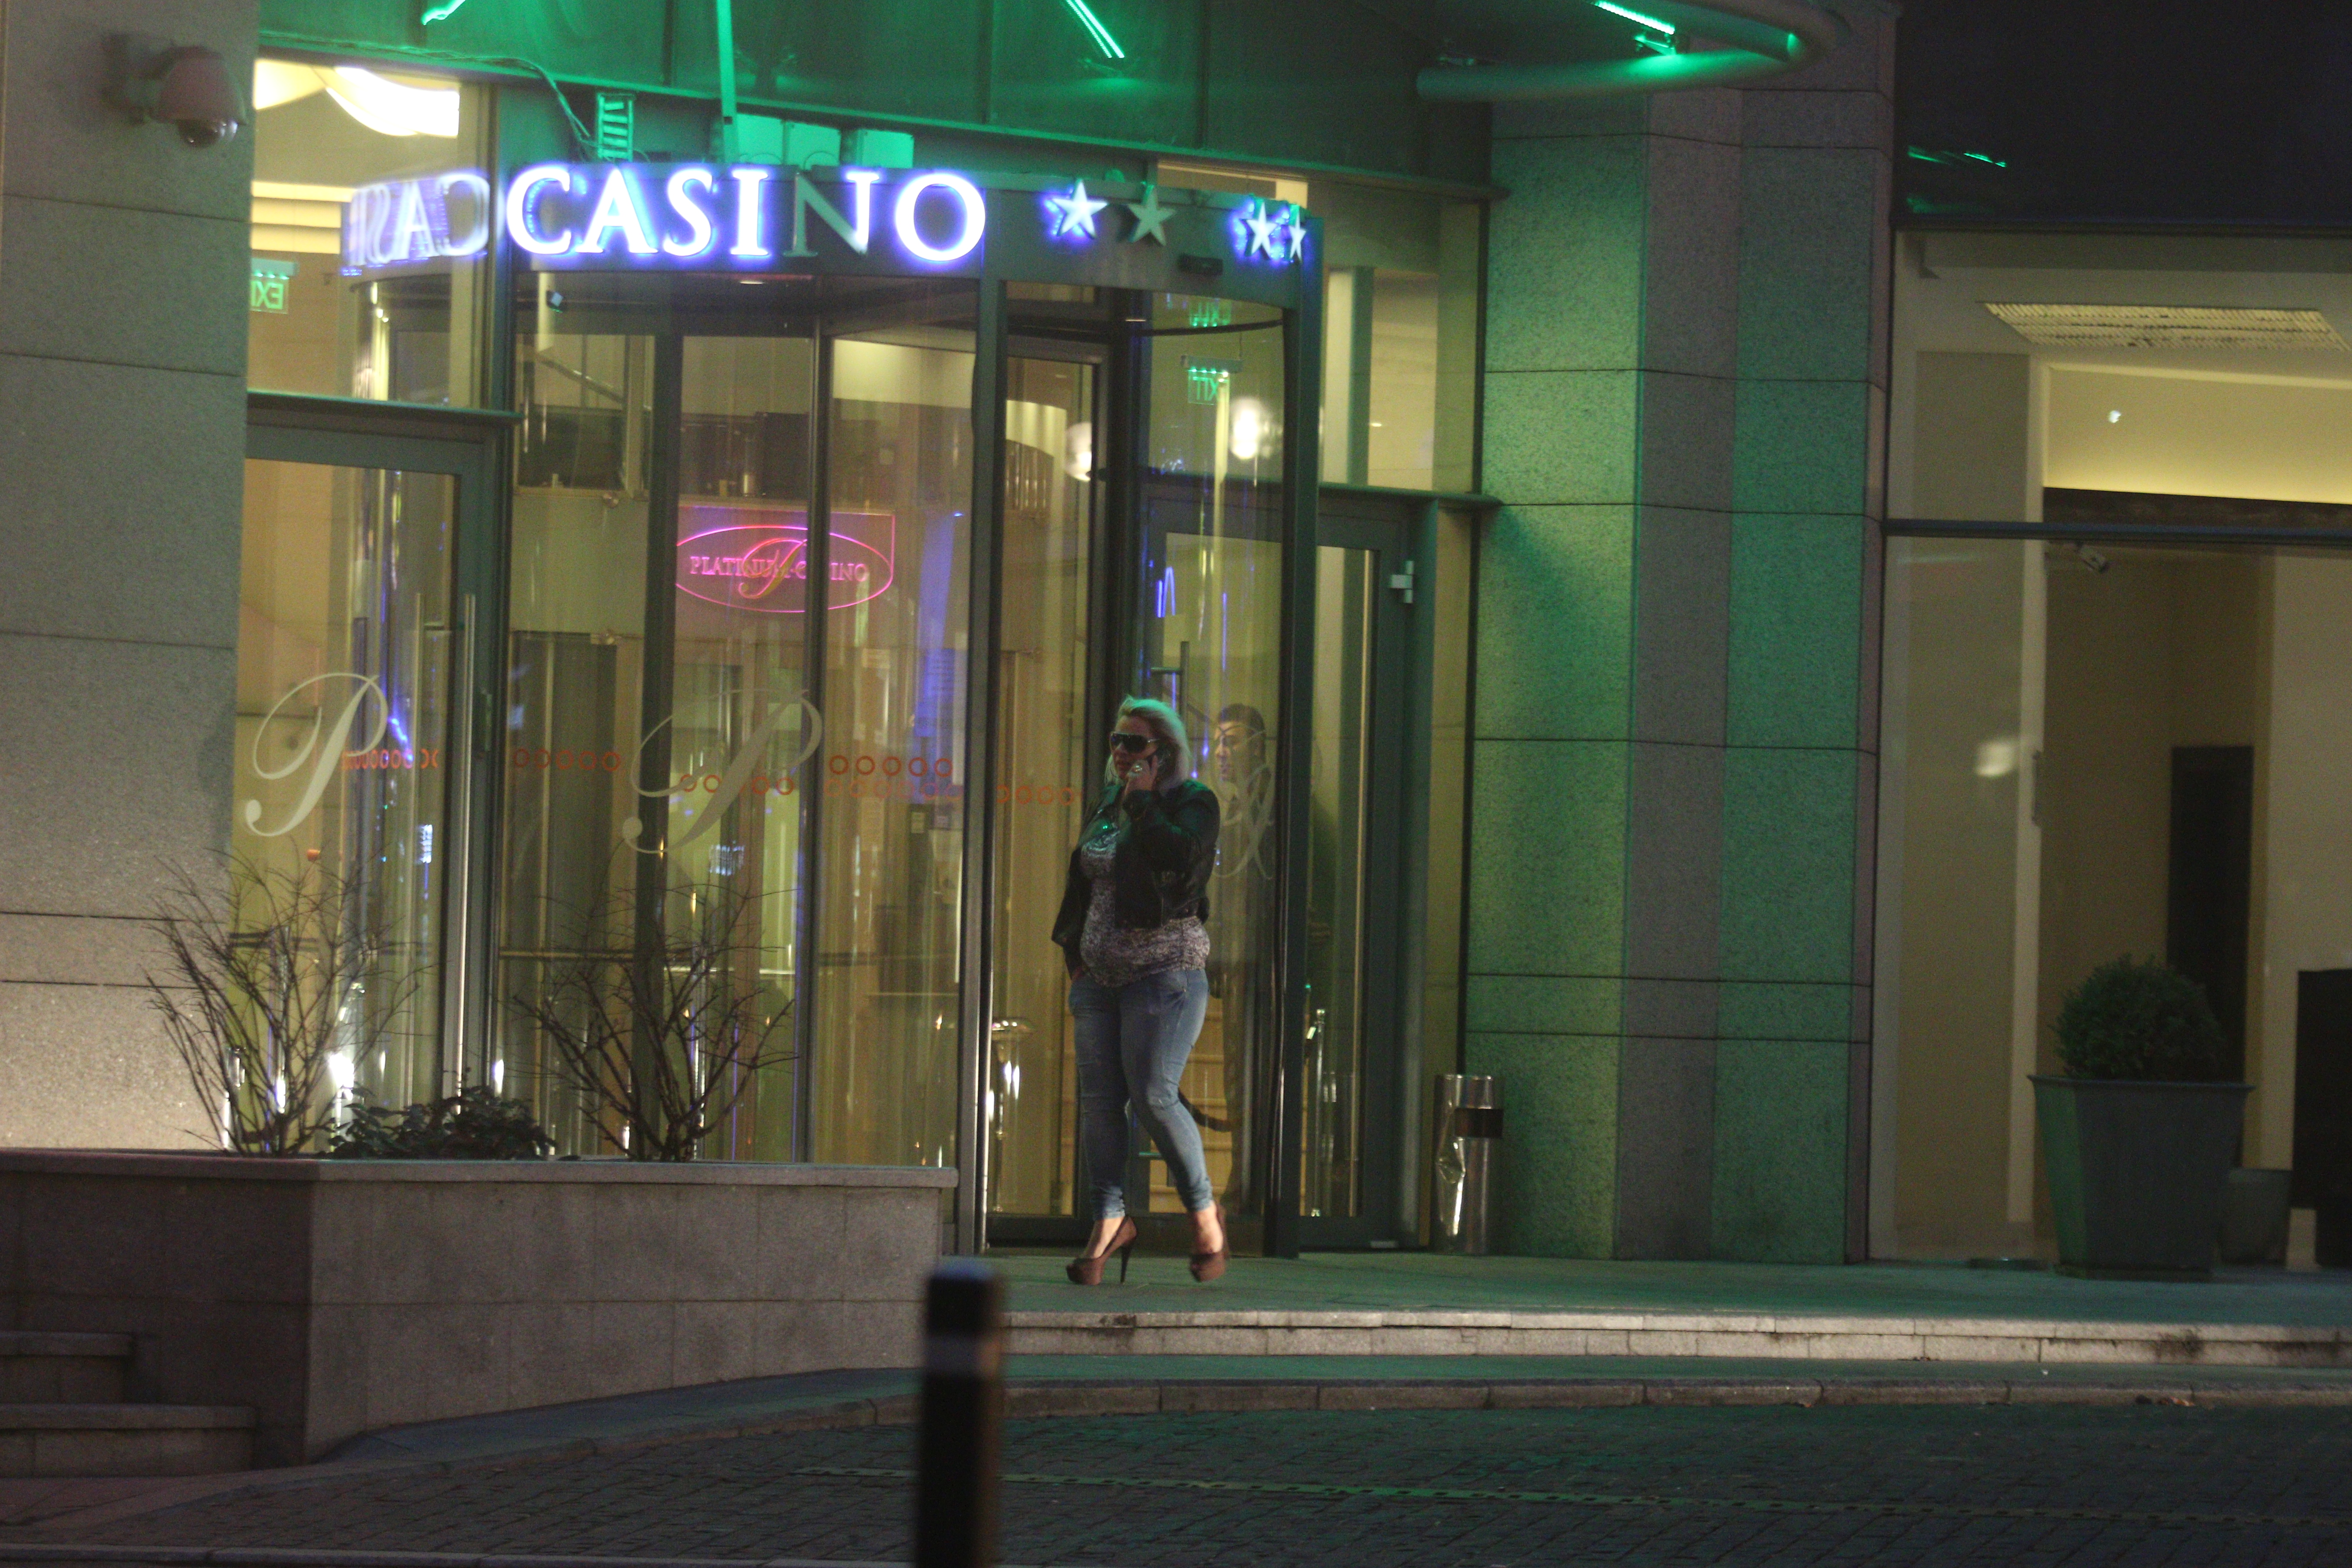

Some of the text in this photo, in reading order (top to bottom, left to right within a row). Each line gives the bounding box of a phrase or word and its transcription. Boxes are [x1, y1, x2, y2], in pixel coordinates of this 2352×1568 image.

[505, 163, 986, 261] CASINO
[795, 560, 868, 582] CINO
[245, 672, 388, 837] P
